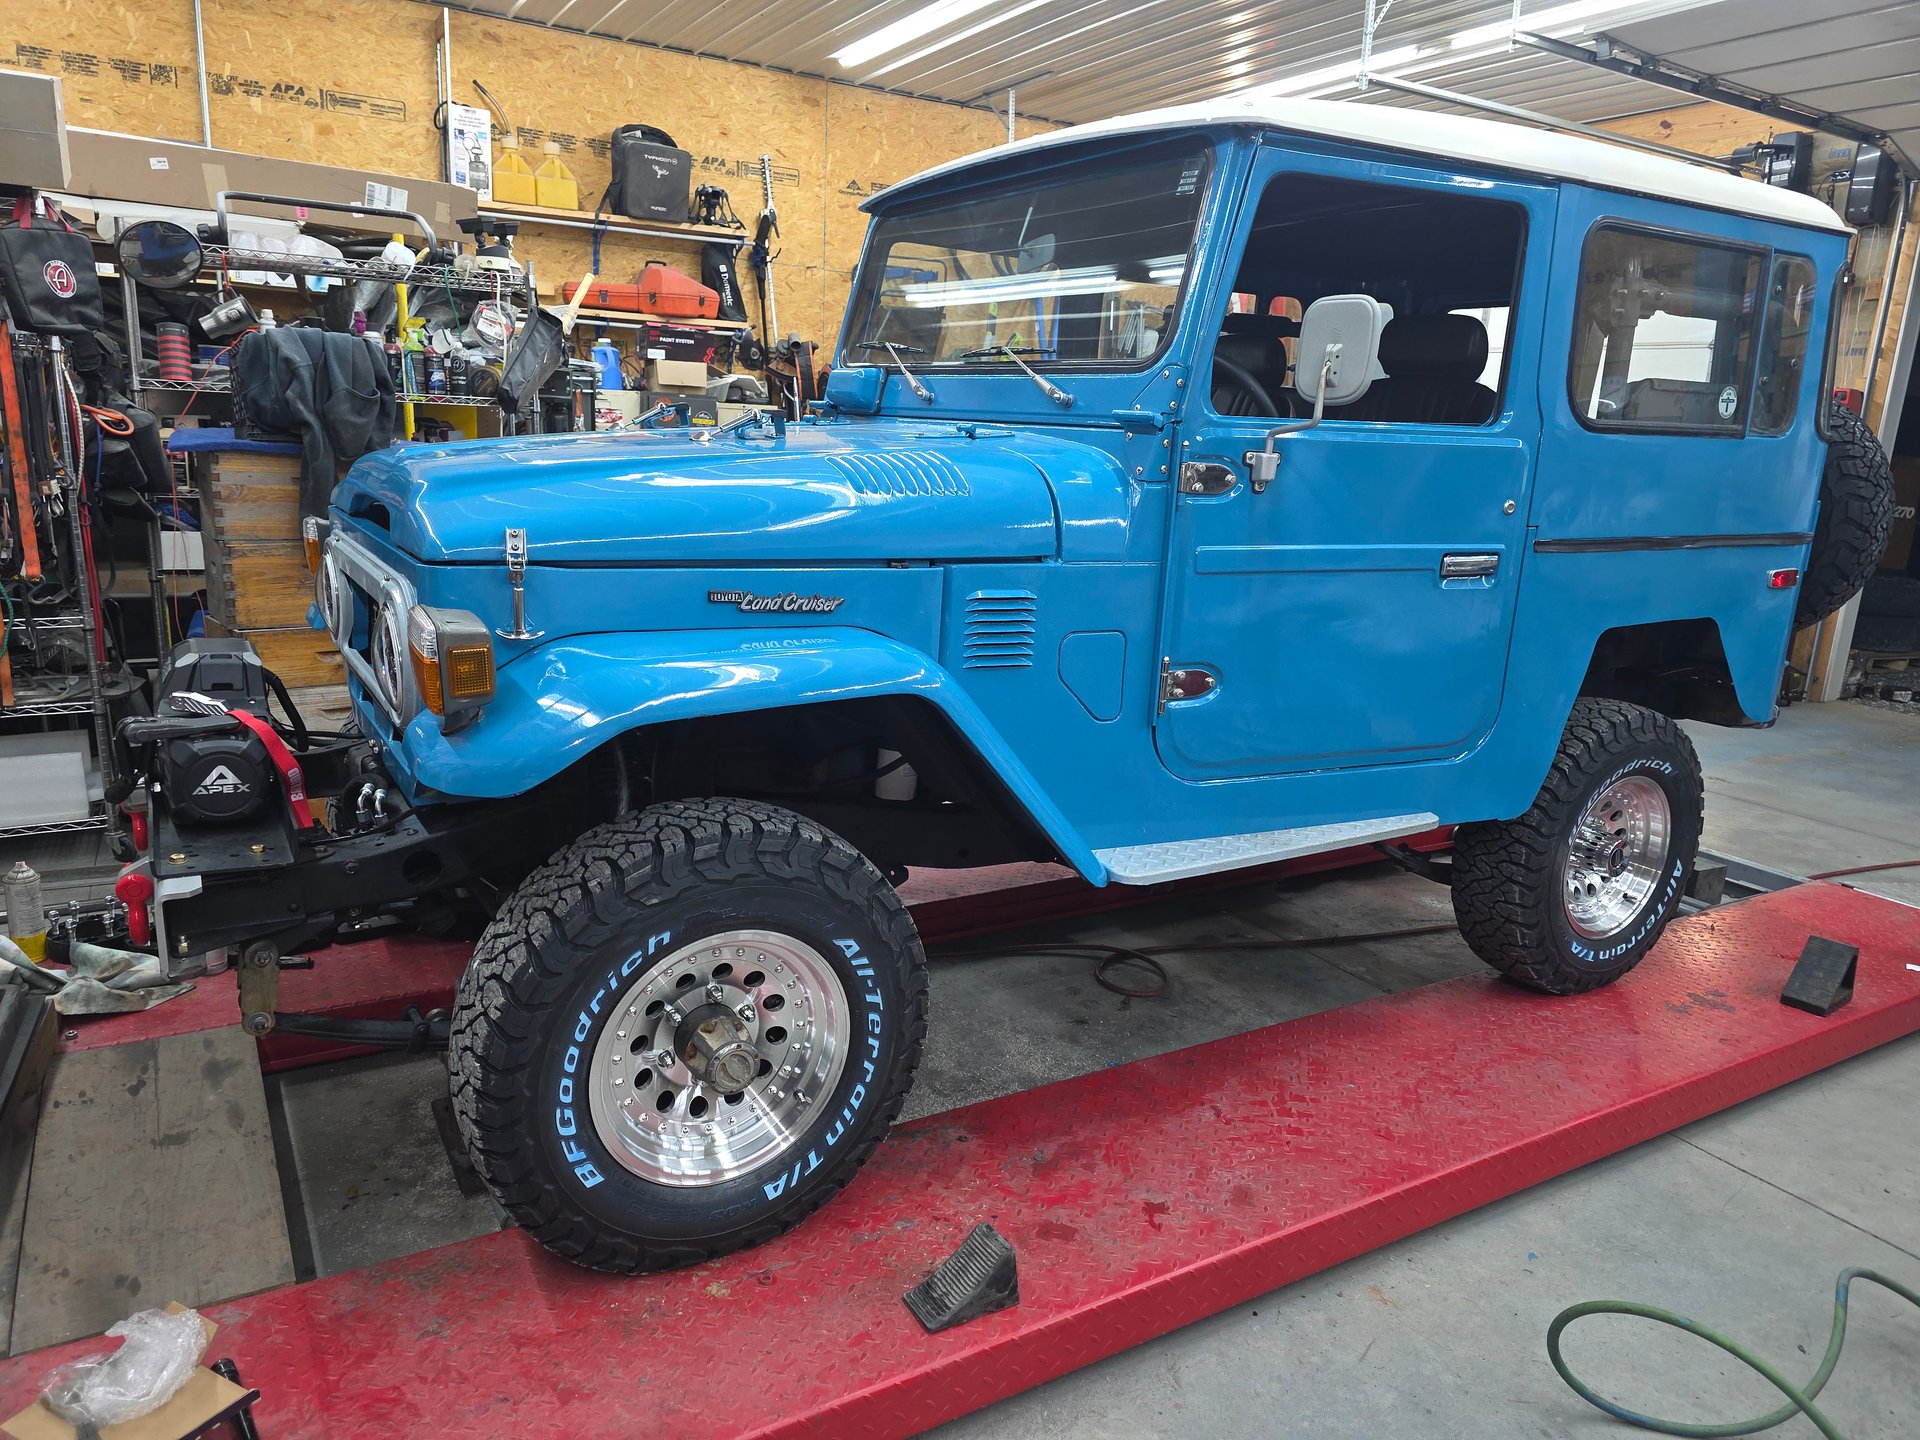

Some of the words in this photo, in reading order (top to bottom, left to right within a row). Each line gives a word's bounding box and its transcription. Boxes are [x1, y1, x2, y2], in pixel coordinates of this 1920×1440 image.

[271, 82, 305, 96] APA
[643, 154, 672, 163] TYPHOON
[701, 156, 726, 168] APA
[721, 273, 734, 306] Dometic
[710, 592, 743, 602] TOYOTA
[741, 591, 782, 611] Land
[783, 592, 846, 611] Cruiser
[192, 784, 250, 796] APEX
[1599, 858, 1683, 961] All-Terrain
[1570, 940, 1595, 962] T/A
[824, 937, 884, 1154] All-Terrain
[555, 929, 672, 1190] BFGoodrich
[763, 1149, 825, 1201] T/A
